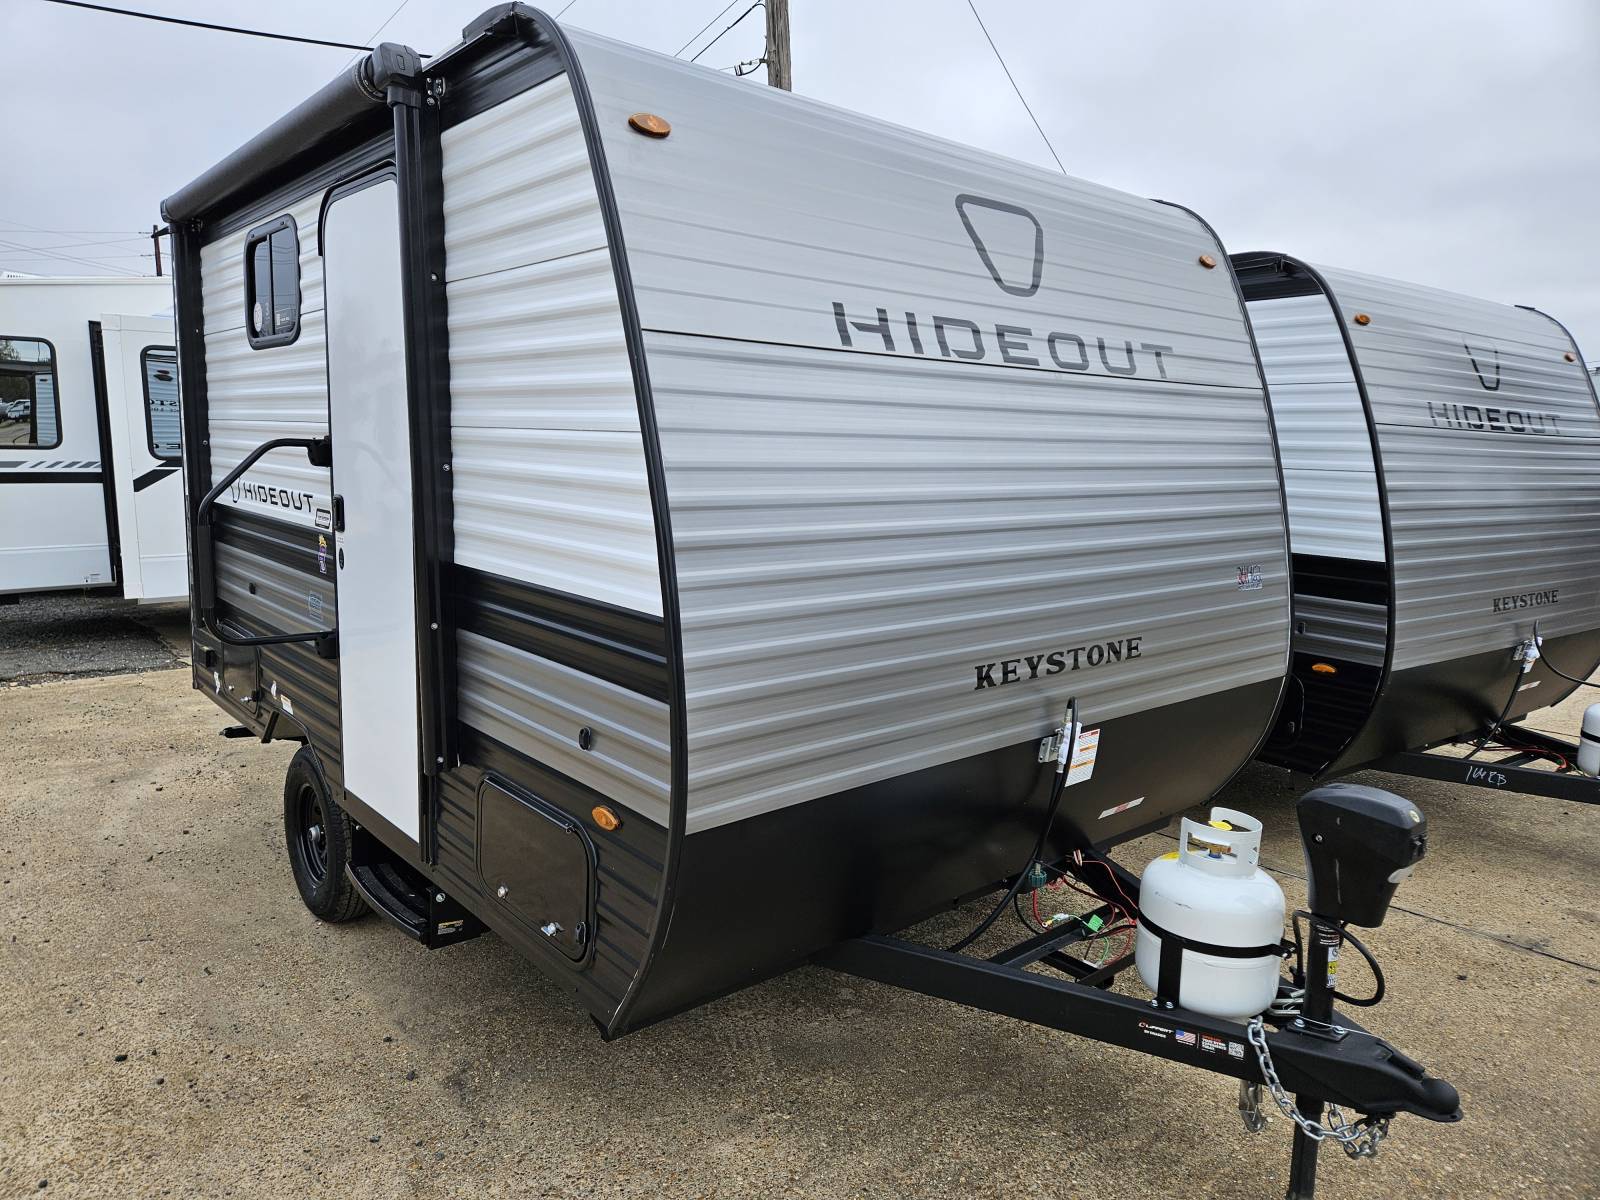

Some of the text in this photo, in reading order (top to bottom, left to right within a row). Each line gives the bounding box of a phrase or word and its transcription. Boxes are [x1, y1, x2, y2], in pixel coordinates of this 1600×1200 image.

[832, 301, 1174, 378] HIDEOUT
[1427, 401, 1560, 434] HIDEOUT
[243, 482, 313, 512] HIDEOUT
[1493, 590, 1559, 612] KEYSTONE
[974, 637, 1142, 690] KEYSTONE
